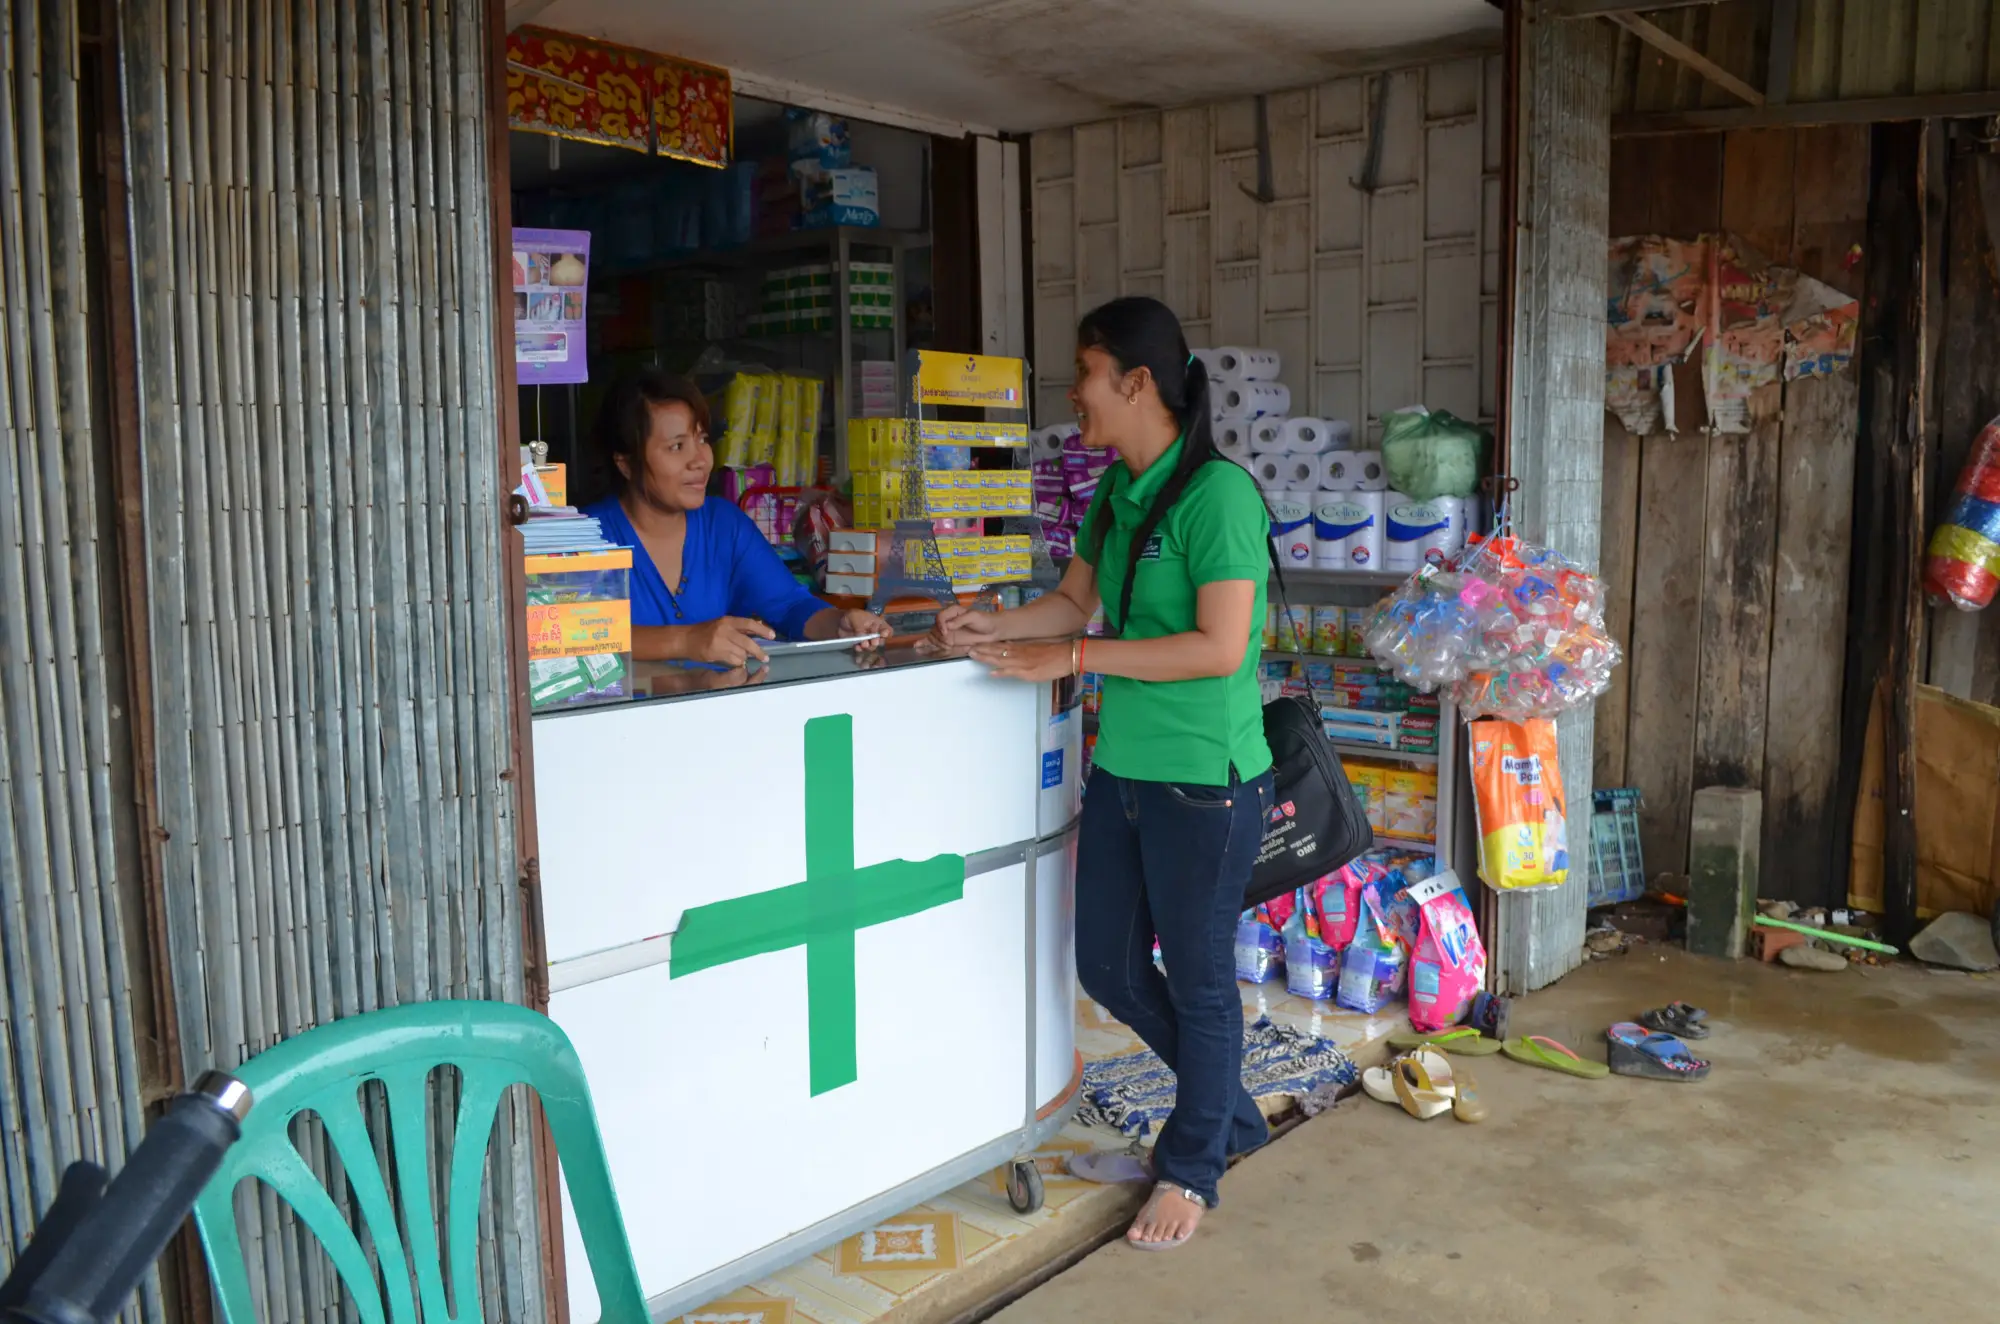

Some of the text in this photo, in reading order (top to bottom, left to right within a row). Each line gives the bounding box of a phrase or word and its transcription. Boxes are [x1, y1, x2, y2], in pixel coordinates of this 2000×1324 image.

[1394, 505, 1438, 519] Cellox
[1324, 623, 1337, 642] 3
[1402, 718, 1435, 729] Colgate
[1400, 735, 1432, 746] Colgate
[1296, 841, 1317, 857] OMF
